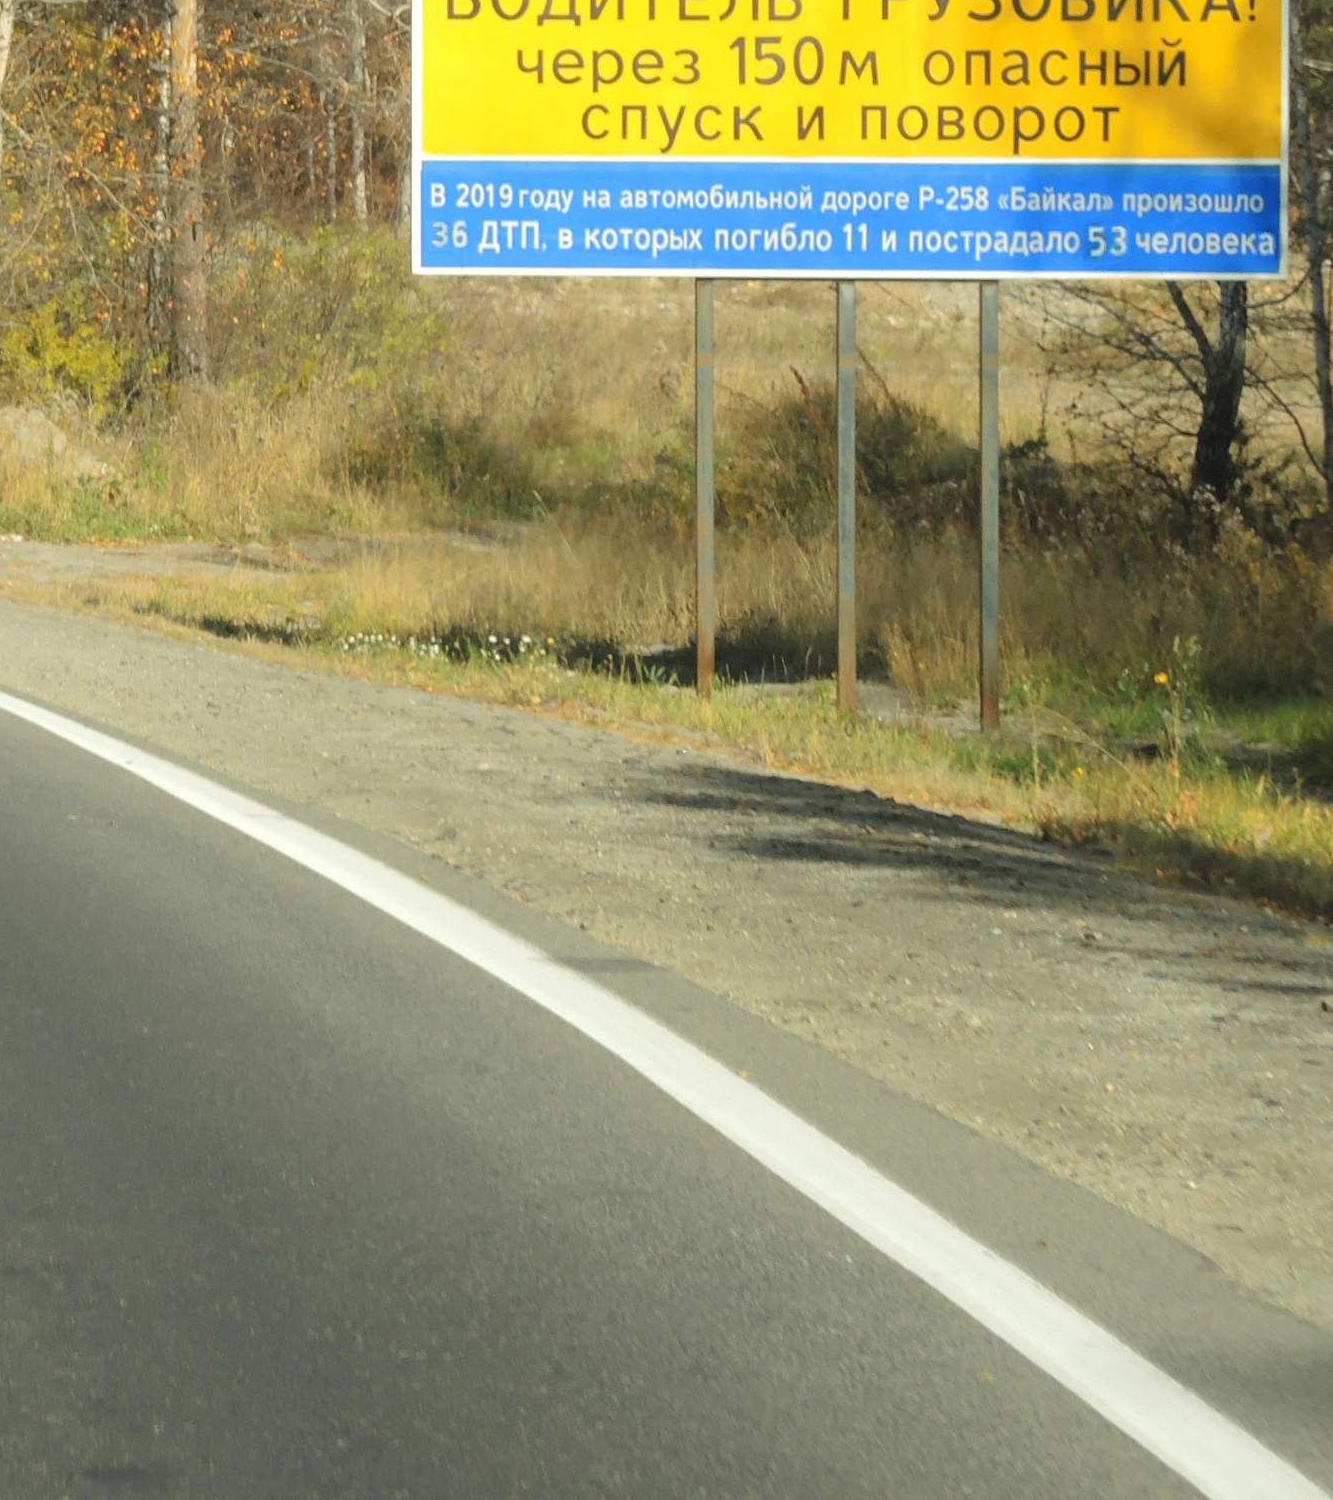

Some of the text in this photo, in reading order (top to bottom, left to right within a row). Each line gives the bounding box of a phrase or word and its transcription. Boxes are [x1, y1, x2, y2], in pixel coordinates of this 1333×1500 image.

[517, 49, 701, 93] через
[923, 38, 1187, 87] опасный
[581, 104, 1120, 155] спуск и поворот
[430, 182, 1265, 218] В 2019 году на автомобильной дороге Р-258 «Байкал» произошло
[431, 219, 469, 249] 36
[557, 227, 574, 250] в
[583, 227, 703, 257] которых
[714, 222, 833, 252] погибло
[843, 223, 869, 251] 11
[880, 230, 898, 253] и
[908, 230, 1081, 259] пострадало
[1087, 225, 1127, 257] 53
[1135, 231, 1275, 256] человека
